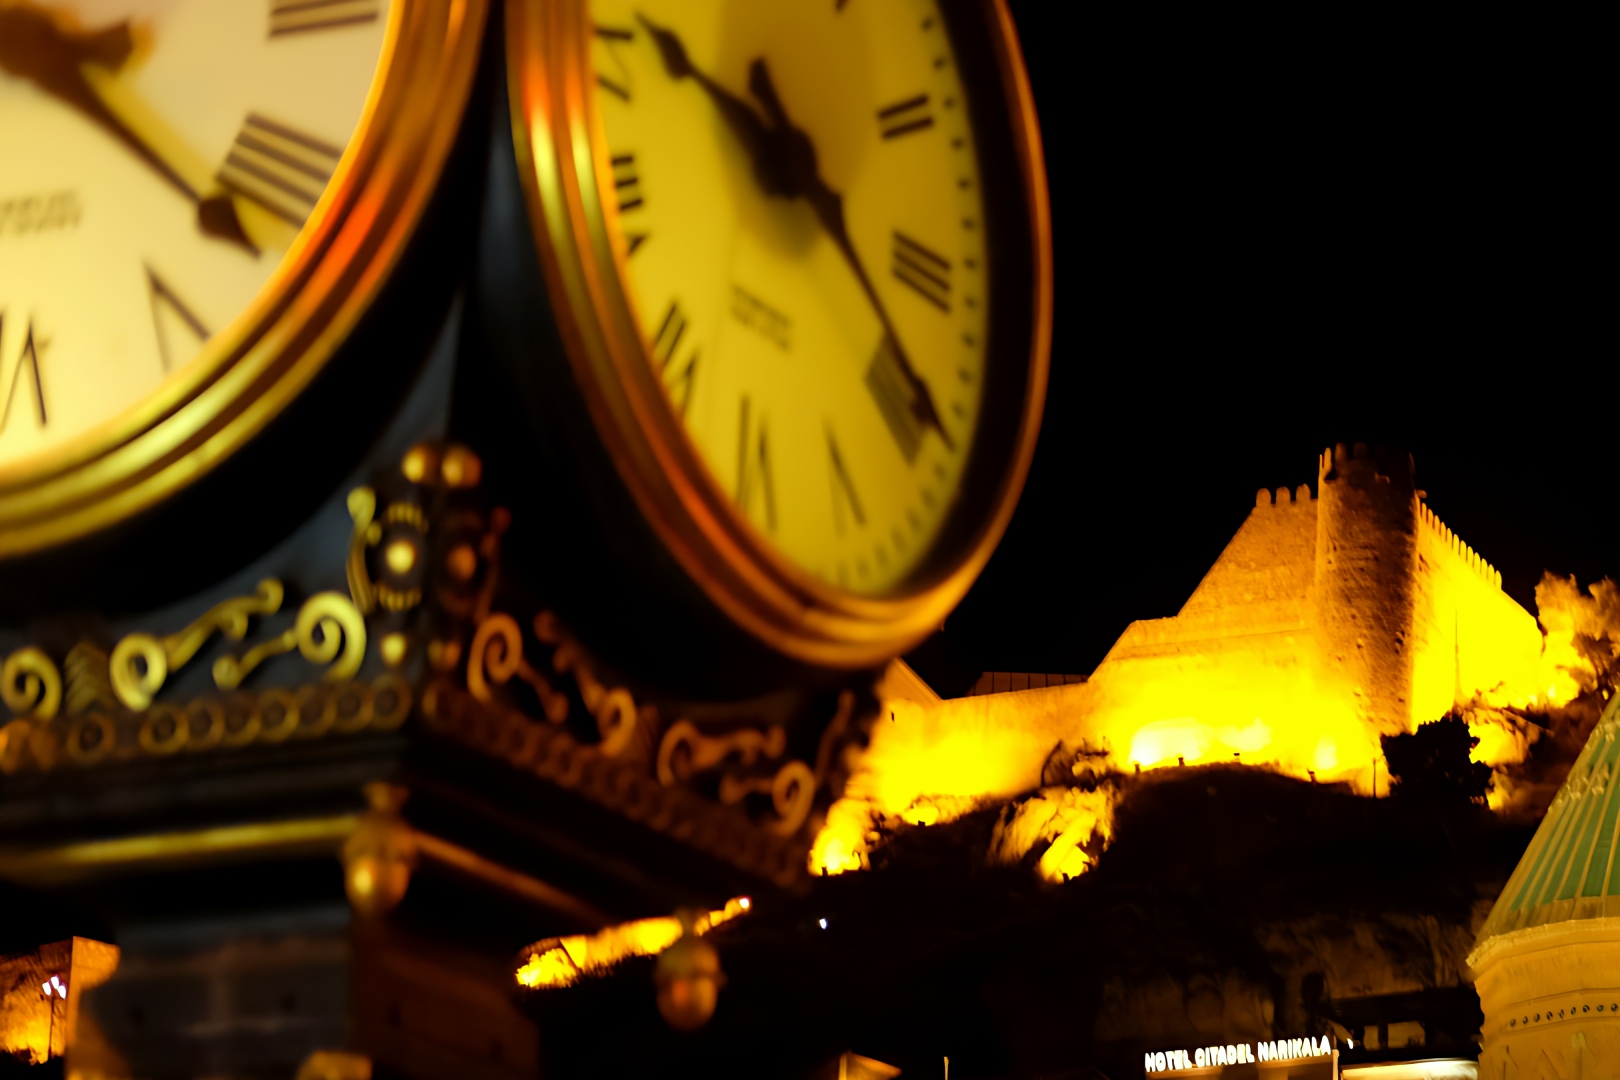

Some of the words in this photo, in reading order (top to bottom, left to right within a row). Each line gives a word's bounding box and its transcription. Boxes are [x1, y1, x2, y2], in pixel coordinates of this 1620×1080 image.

[1144, 1049, 1192, 1073] HOTEL
[1195, 1043, 1255, 1068] CITADEL
[1257, 1034, 1332, 1063] NARIKALA
